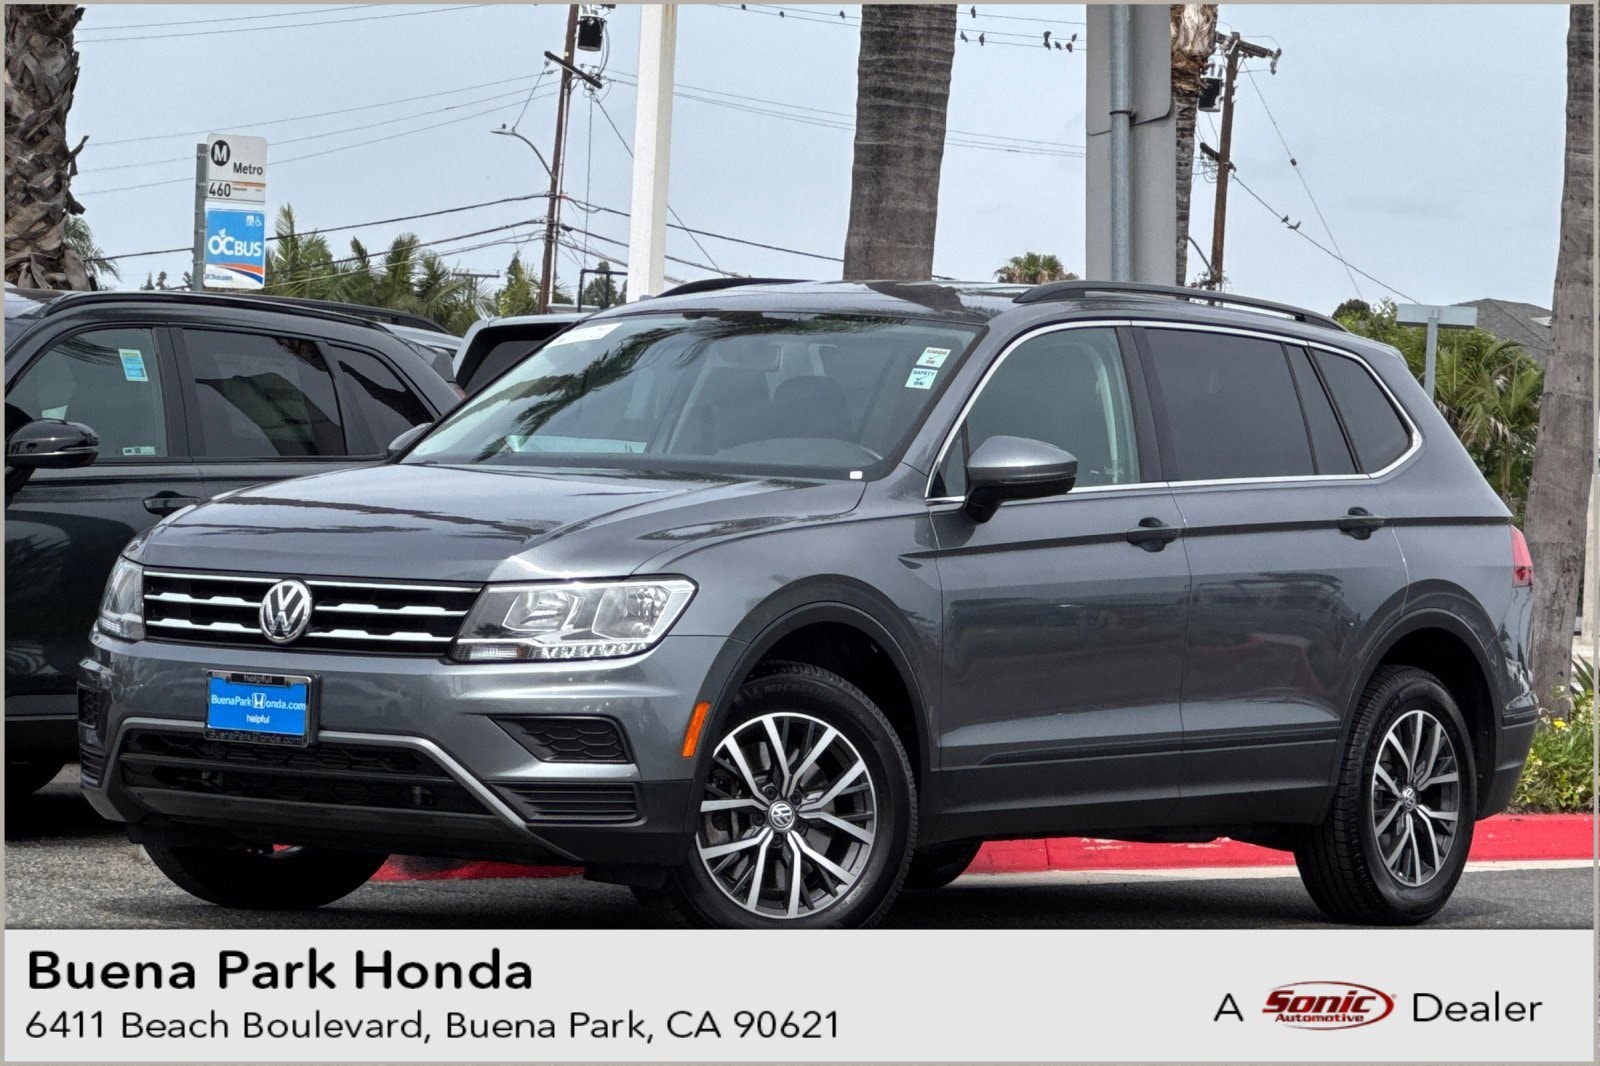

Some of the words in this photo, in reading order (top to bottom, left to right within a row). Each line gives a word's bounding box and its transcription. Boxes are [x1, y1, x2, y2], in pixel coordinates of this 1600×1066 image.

[233, 162, 264, 175] Metro
[209, 183, 231, 197] 460
[244, 674, 272, 684] helpful
[246, 714, 270, 725] helpful
